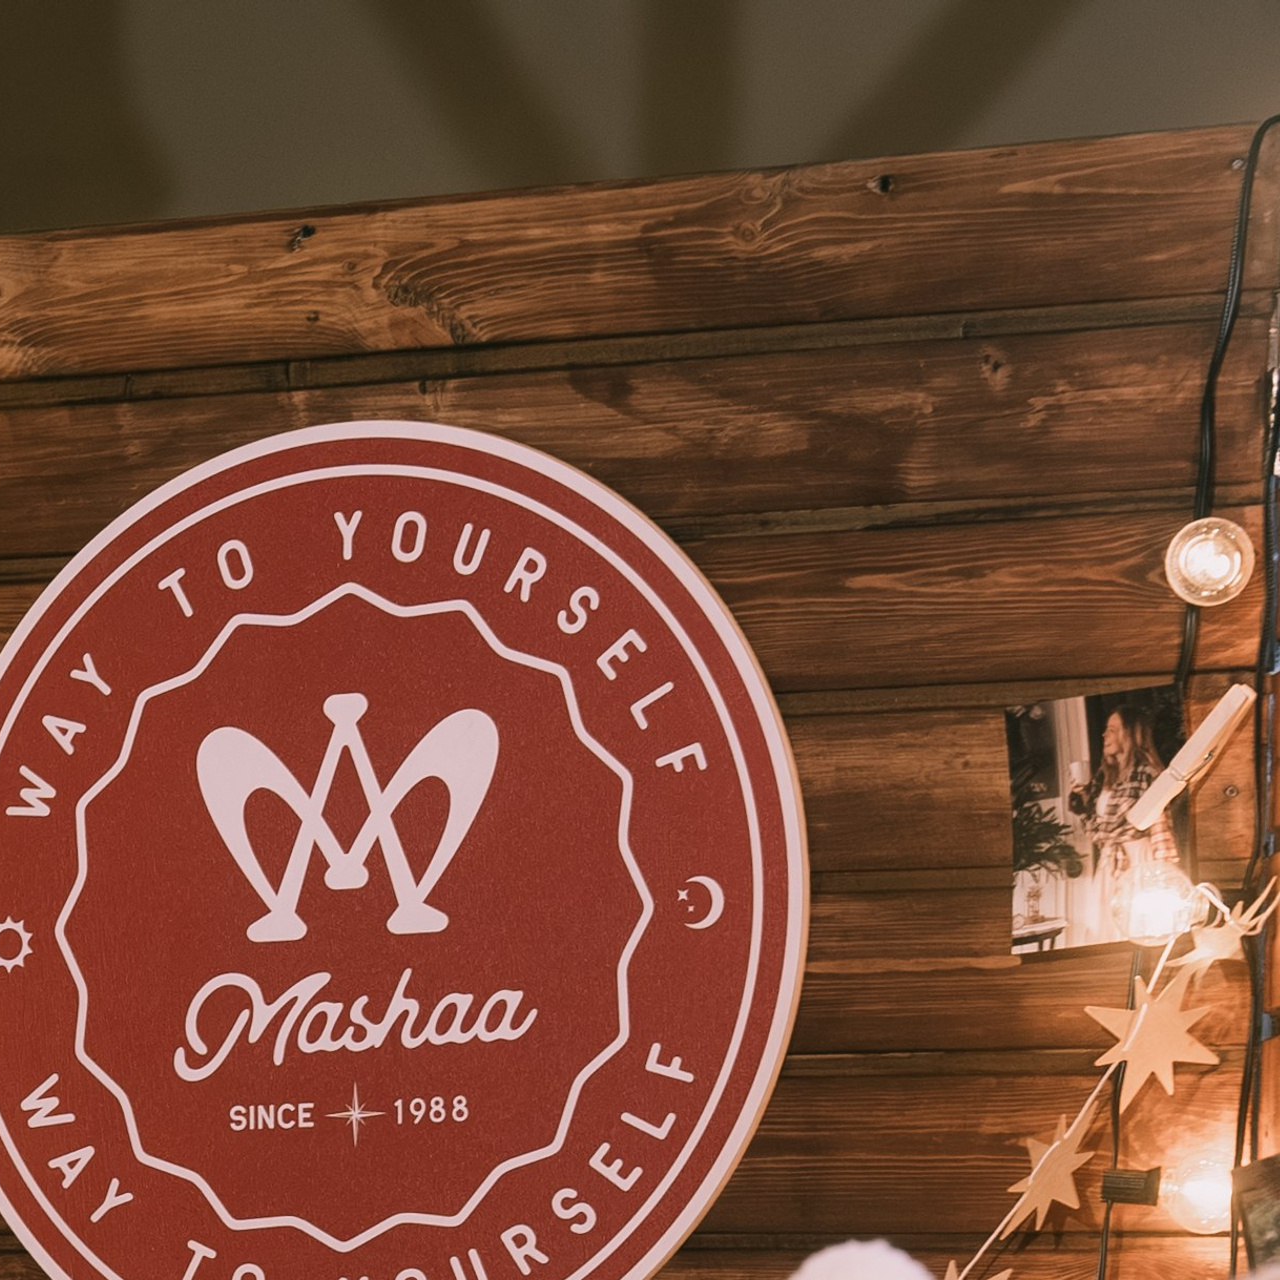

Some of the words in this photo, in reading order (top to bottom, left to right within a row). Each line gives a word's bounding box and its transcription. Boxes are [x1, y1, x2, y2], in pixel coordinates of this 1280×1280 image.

[5, 652, 112, 817] WAY
[157, 539, 254, 618] TO
[333, 510, 708, 773] YOURSELF
[173, 967, 538, 1082] Mashaa
[20, 1073, 134, 1223] WAY
[229, 1102, 315, 1132] SINCE
[393, 1096, 469, 1126] 1988
